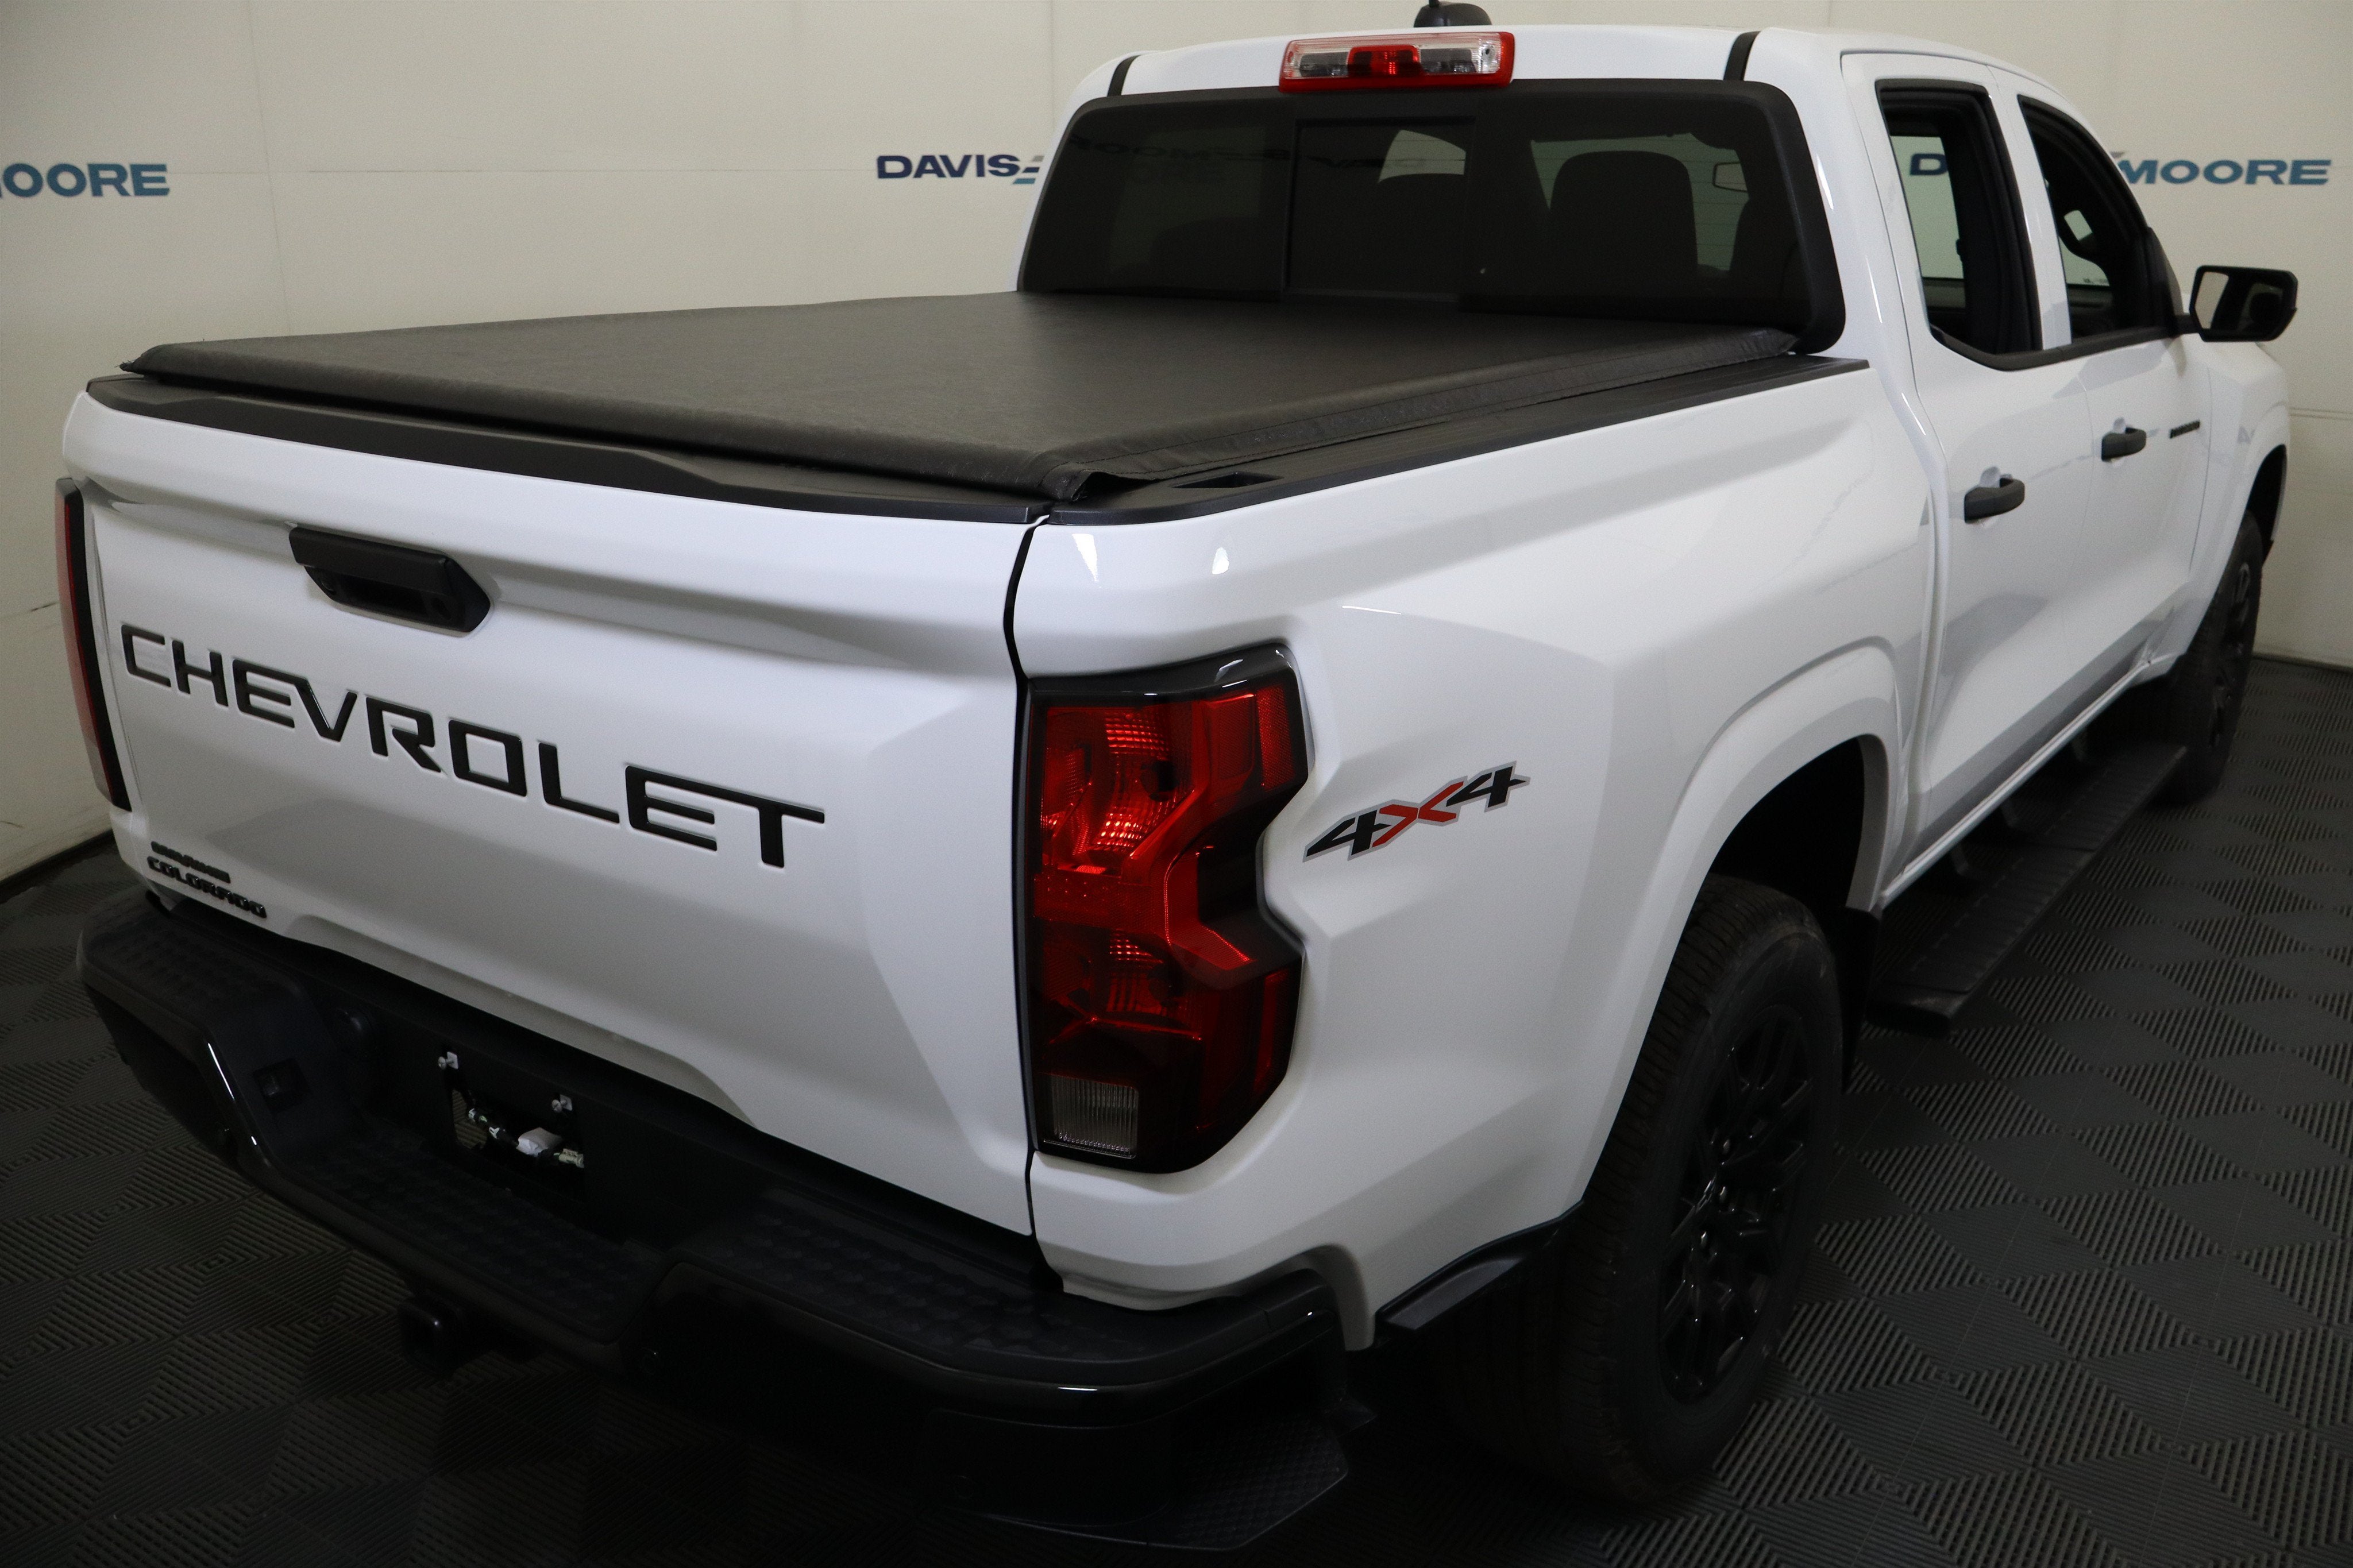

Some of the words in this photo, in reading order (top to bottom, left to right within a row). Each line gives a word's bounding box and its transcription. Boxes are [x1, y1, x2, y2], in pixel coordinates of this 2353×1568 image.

[0, 163, 170, 198] OORE
[877, 154, 1021, 179] DAVIS
[2117, 159, 2331, 185] MOORE
[121, 624, 825, 868] CHEVROLET
[147, 856, 267, 918] COLORADO
